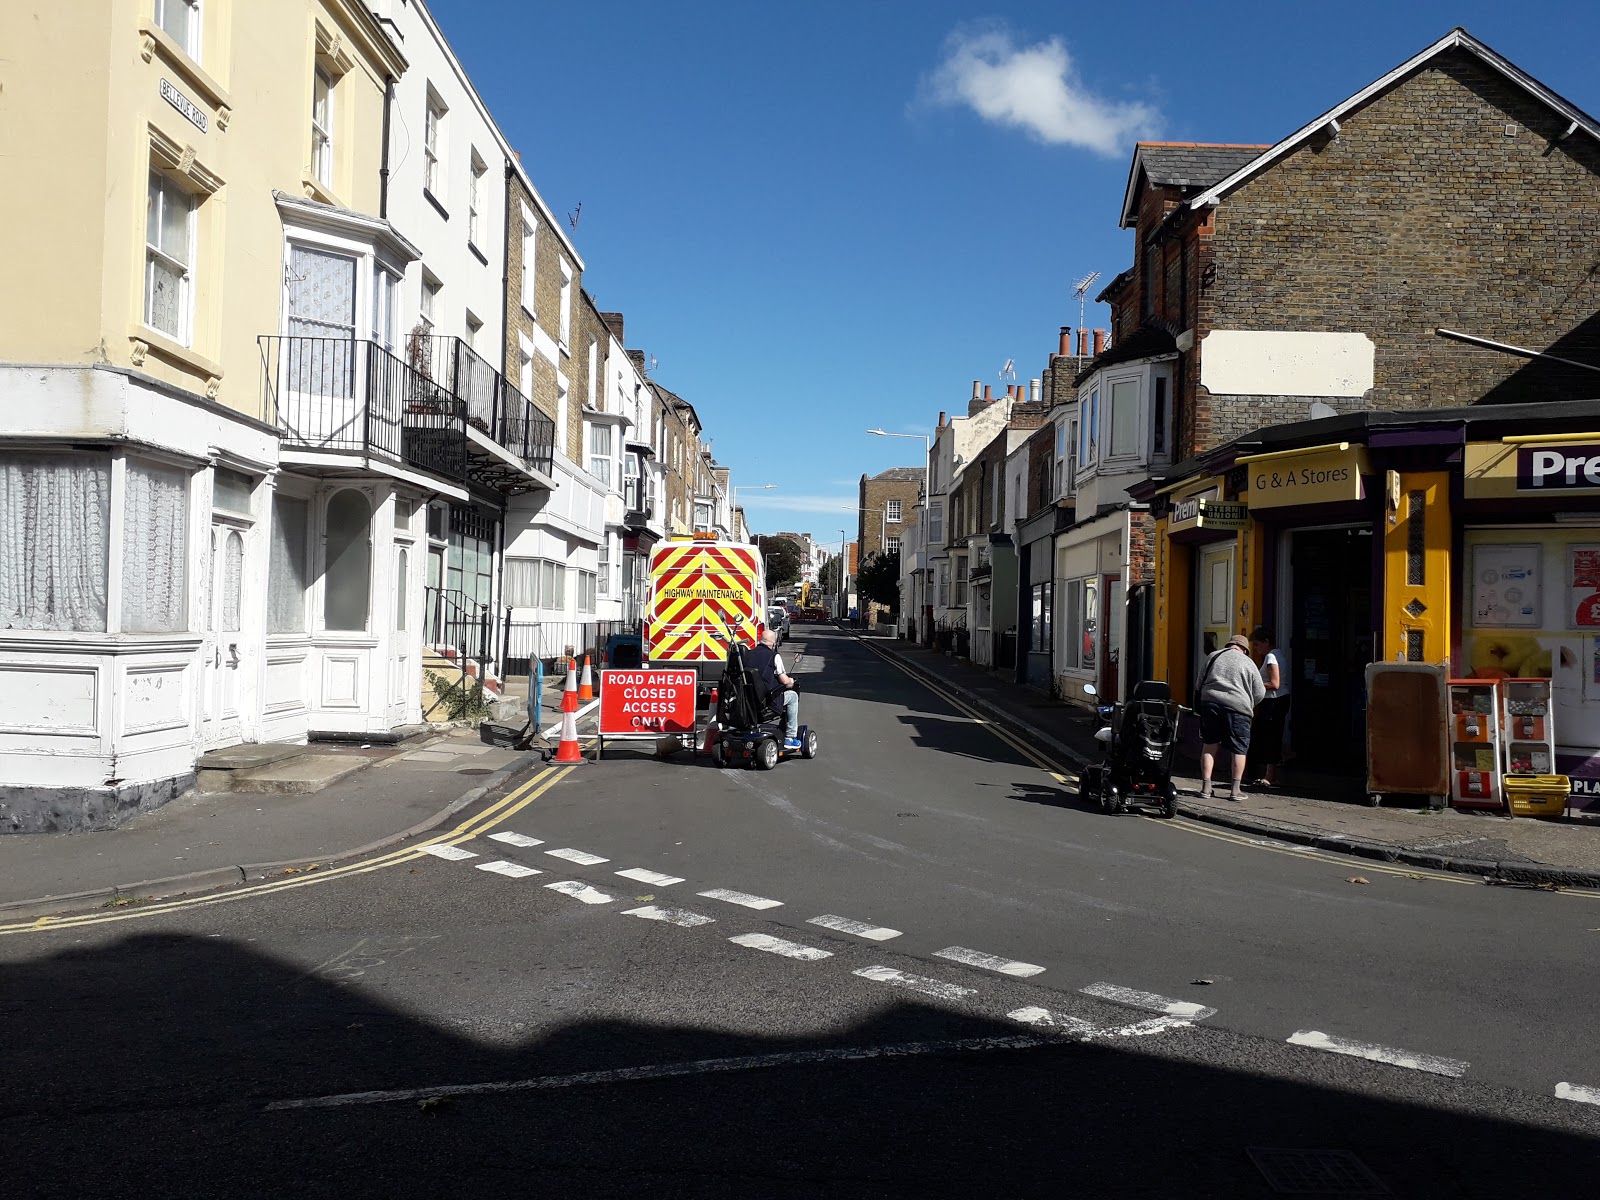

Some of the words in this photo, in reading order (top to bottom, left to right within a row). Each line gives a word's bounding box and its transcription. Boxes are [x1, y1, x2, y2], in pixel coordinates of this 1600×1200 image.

[162, 81, 190, 116] BELLEVUE
[191, 107, 206, 129] ROAD
[1256, 474, 1266, 490] G
[1271, 472, 1282, 489] &
[1286, 470, 1297, 487] A
[1301, 468, 1348, 485] Stores
[664, 588, 695, 599] HIGHWAY
[696, 589, 744, 600] MAINTENANCE
[608, 674, 645, 685] ROAD
[647, 674, 693, 686] AHEAD
[623, 687, 677, 699] CLOSED
[622, 702, 676, 713] ACCESS
[631, 716, 667, 727] ONLY
